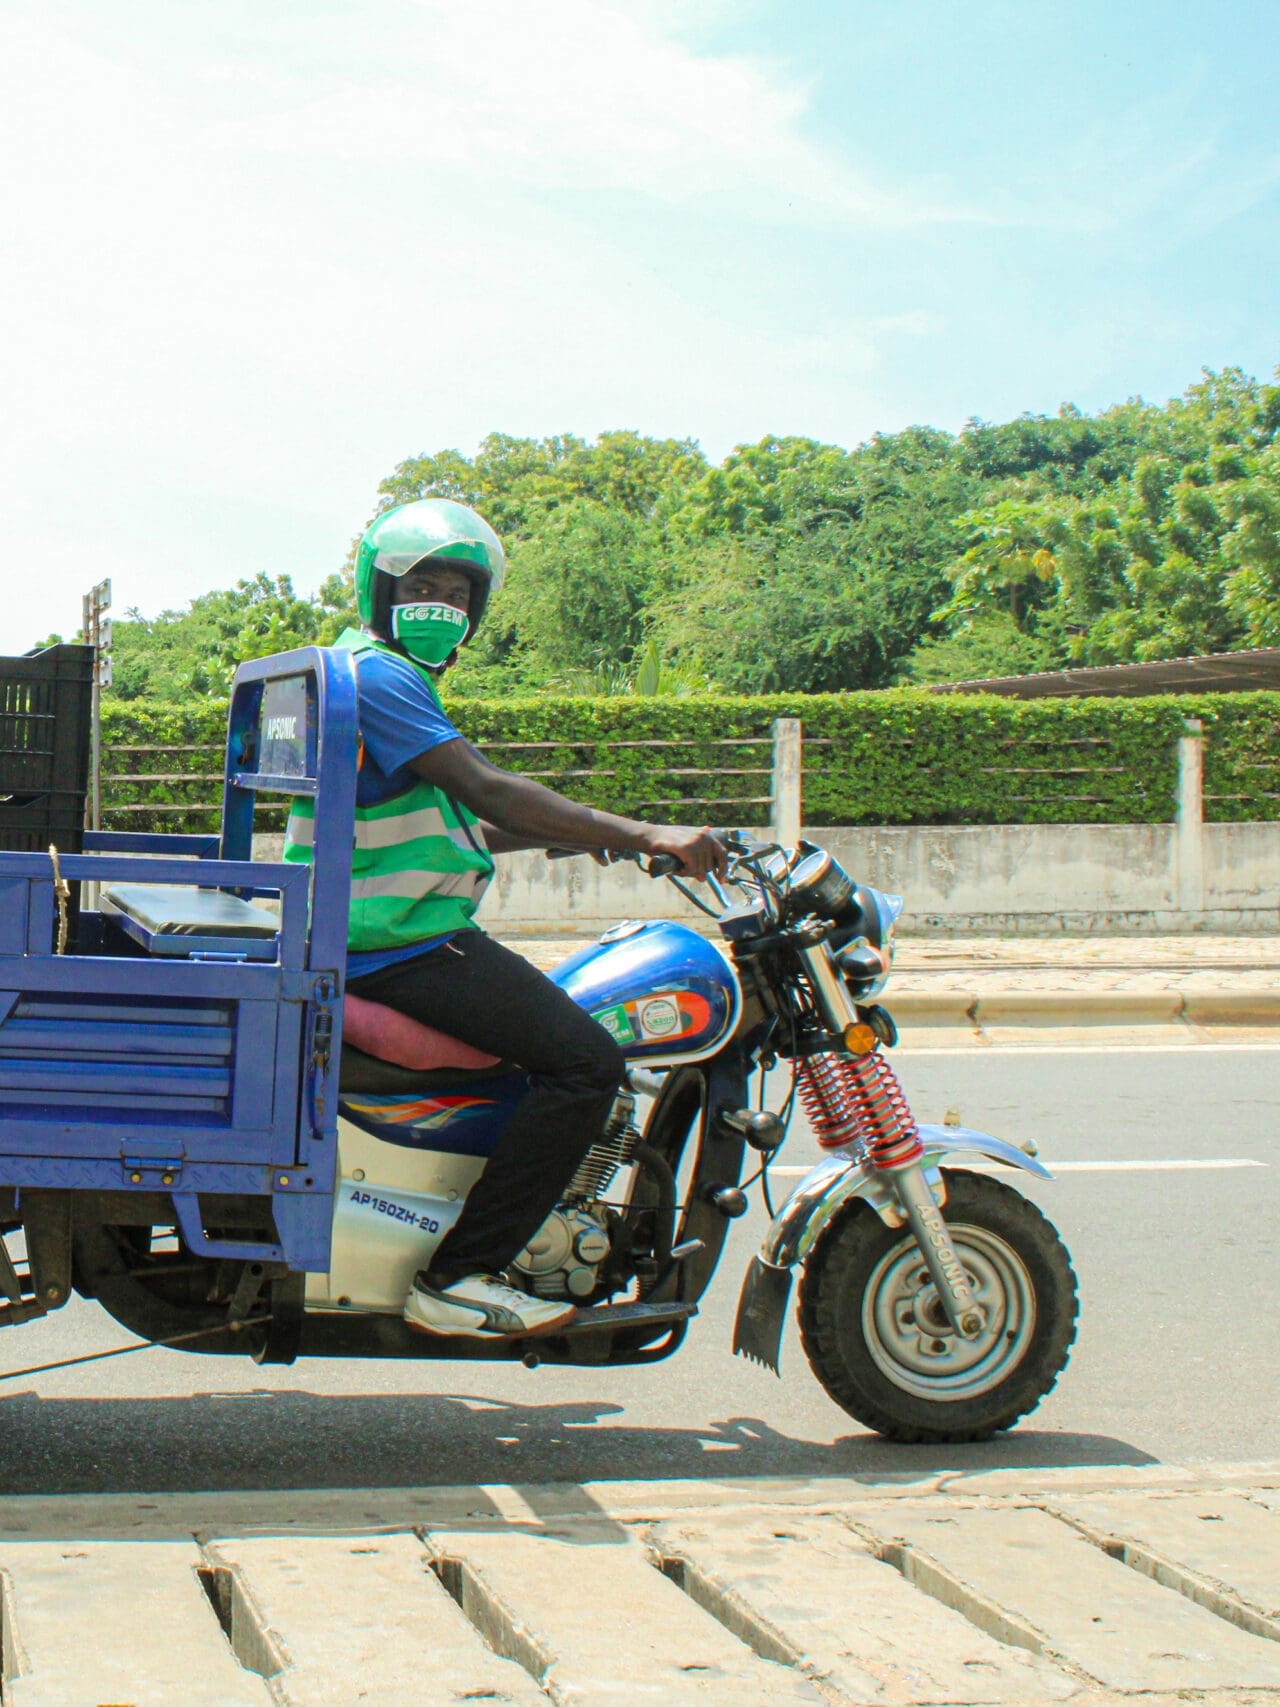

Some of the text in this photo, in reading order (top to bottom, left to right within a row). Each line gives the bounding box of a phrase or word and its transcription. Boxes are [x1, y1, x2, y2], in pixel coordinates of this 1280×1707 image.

[401, 607, 463, 627] GOZEM
[266, 716, 297, 740] APSONIC
[350, 1190, 439, 1234] AP150ZH-20
[915, 1205, 968, 1300] APSONIC
